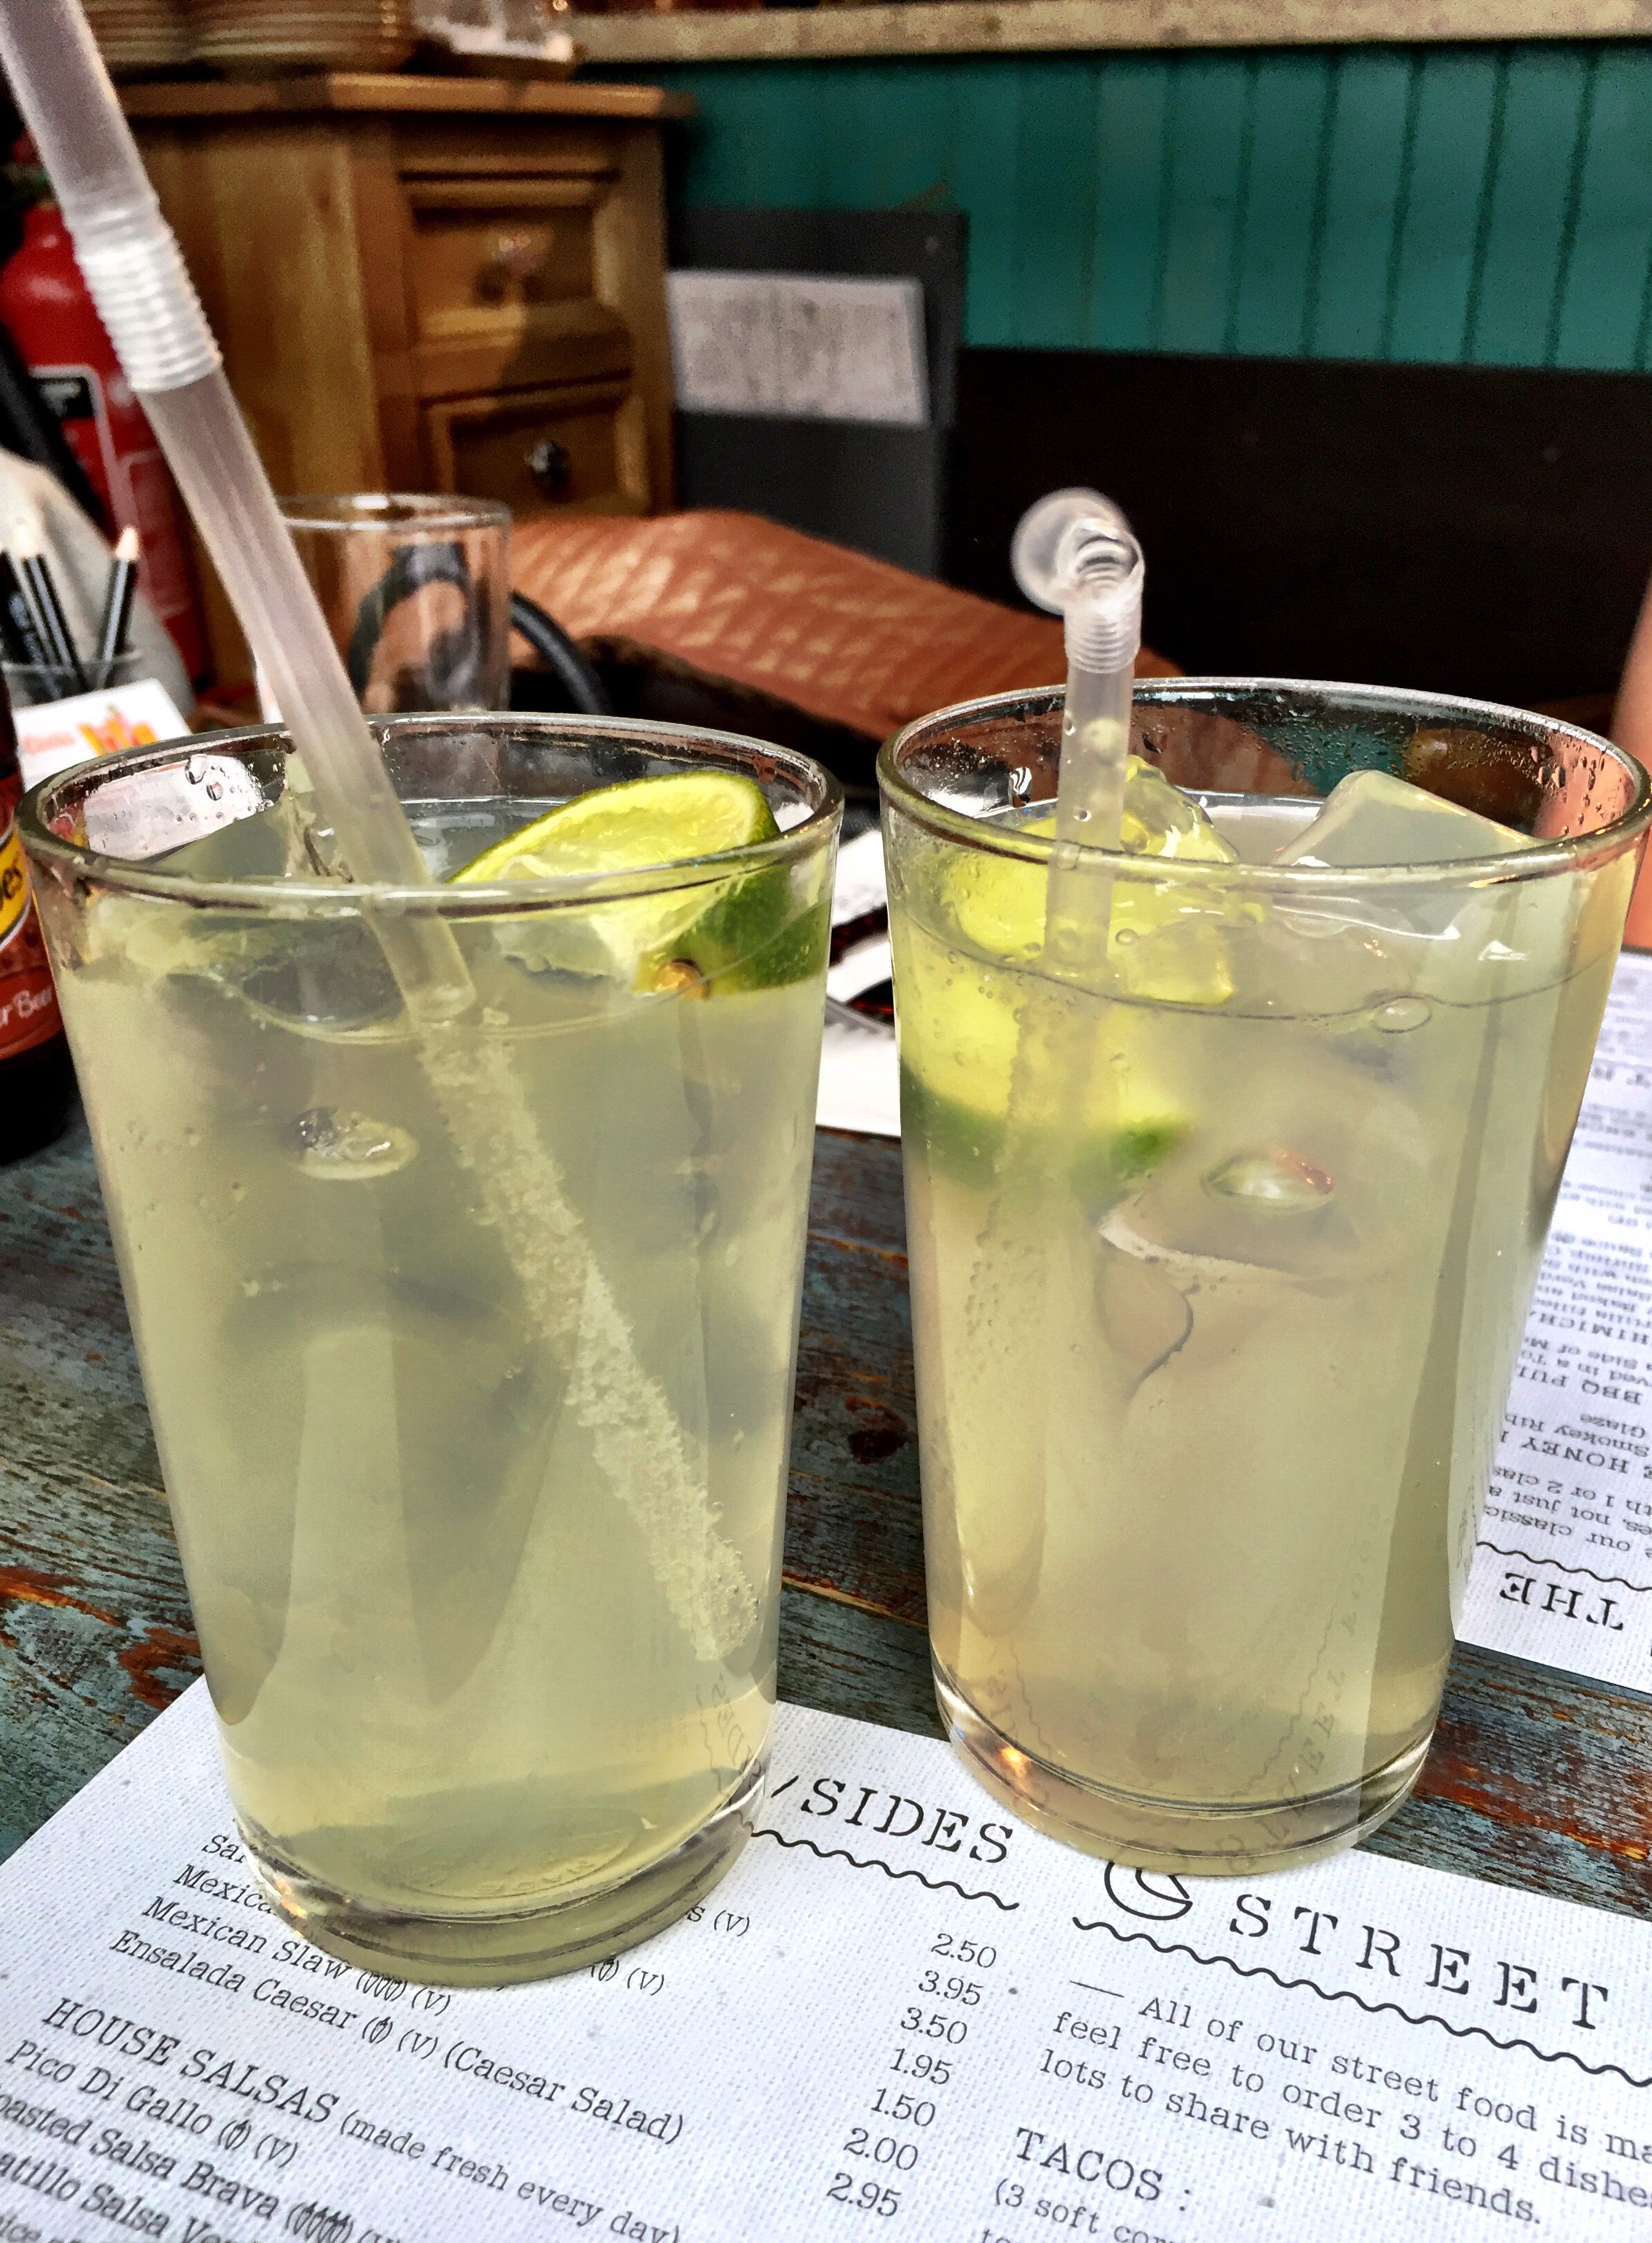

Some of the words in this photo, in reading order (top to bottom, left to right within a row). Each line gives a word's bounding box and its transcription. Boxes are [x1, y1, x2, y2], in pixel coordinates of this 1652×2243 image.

[1582, 1379, 1644, 1405] BBQ
[1522, 1436, 1630, 1474] HONEY
[1554, 1424, 1650, 1457] Smokey
[1580, 1414, 1646, 1439] Glaze
[1513, 1491, 1562, 1516] just
[1548, 1481, 1562, 1494] 2
[1570, 1486, 1597, 1503] or
[1570, 1506, 1611, 1527] not
[1586, 1532, 1631, 1553] our
[1499, 1572, 1624, 1631] THE
[714, 1910, 750, 1937] (V)
[918, 1970, 983, 2006] 3.95
[930, 1932, 997, 1969] 2.50
[1229, 1893, 1609, 2030] STREET
[141, 1895, 269, 1954] Mexican
[272, 1939, 352, 1981] Slaw
[410, 1986, 452, 2017] (V)
[889, 2048, 954, 2086] 1.95
[627, 1968, 664, 1996] (V)
[899, 2006, 968, 2044] 3.50
[108, 1929, 243, 1993] Ensalada
[252, 1977, 358, 2030] Caesar
[397, 2027, 439, 2059] (V)
[444, 2041, 566, 2103] (Caesar
[571, 2087, 685, 2145] Salad)
[870, 2088, 937, 2128] 1.50
[1138, 1997, 1193, 2028] All
[1206, 2017, 1244, 2043] of
[1256, 2032, 1318, 2065] our
[1331, 2052, 1439, 2103] street
[1456, 2087, 1538, 2132] food
[1556, 2114, 1587, 2145] is
[5, 2039, 78, 2084] Pico
[79, 2066, 125, 2101] Di
[126, 2084, 213, 2135] Gallo
[254, 2133, 299, 2168] (V)
[41, 1997, 183, 2068] HOUSE
[179, 2048, 341, 2124] SALSAS
[340, 2110, 426, 2161] (made
[430, 2146, 510, 2191] fresh
[517, 2181, 604, 2228] every
[1053, 2010, 1122, 2051] feel
[1139, 2035, 1211, 2077] free
[1232, 2064, 1264, 2092] to
[1282, 2083, 1382, 2130] order
[1400, 2114, 1422, 2140] 3
[1442, 2128, 1477, 2158] to
[1497, 2144, 1519, 2171] 4
[1539, 2155, 1652, 2211] dishe
[843, 2127, 920, 2171] 2.00
[1016, 2127, 1163, 2201] TACOS
[1039, 2048, 1105, 2090] lots
[1121, 2073, 1153, 2104] to
[1166, 2091, 1270, 2140] share
[1286, 2126, 1377, 2174] with
[1391, 2157, 1541, 2224] friends.
[90, 2128, 177, 2181] Salsa
[180, 2160, 280, 2221] Brava
[826, 2172, 902, 2218] 2.95
[80, 2182, 171, 2238] Salsa
[995, 2177, 1025, 2208] (3
[1035, 2199, 1099, 2235] soft
